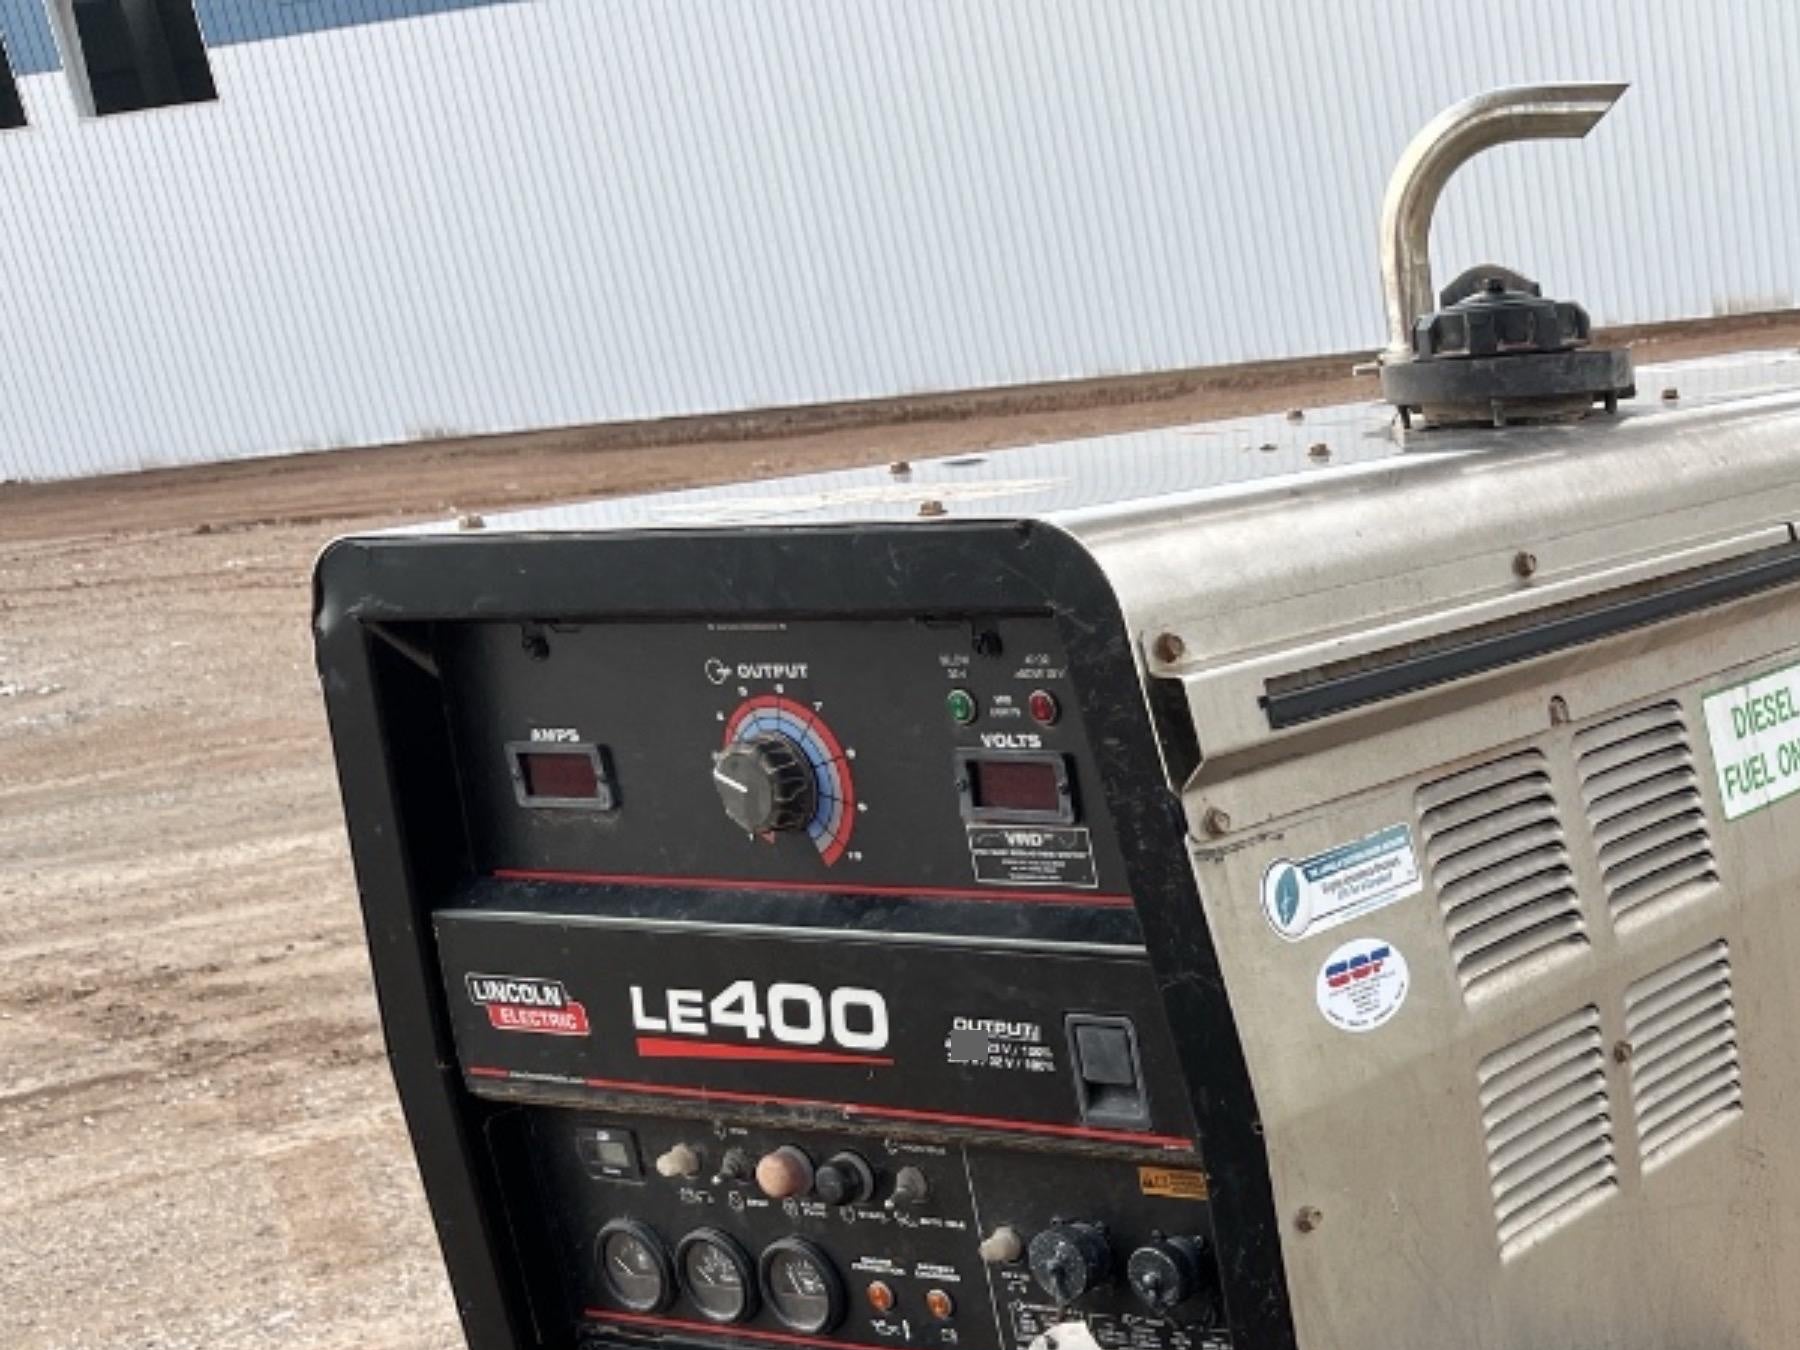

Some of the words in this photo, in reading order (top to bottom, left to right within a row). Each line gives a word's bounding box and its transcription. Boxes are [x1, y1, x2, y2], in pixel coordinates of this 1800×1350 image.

[736, 663, 809, 679] OUTPUT
[1730, 686, 1800, 740] DIESEL
[980, 732, 1043, 749] VOLTS
[1723, 751, 1777, 801] FUEL
[472, 979, 563, 1007] LINCOLN
[499, 1007, 578, 1031] ELECTRIC
[629, 979, 890, 1051] LE400
